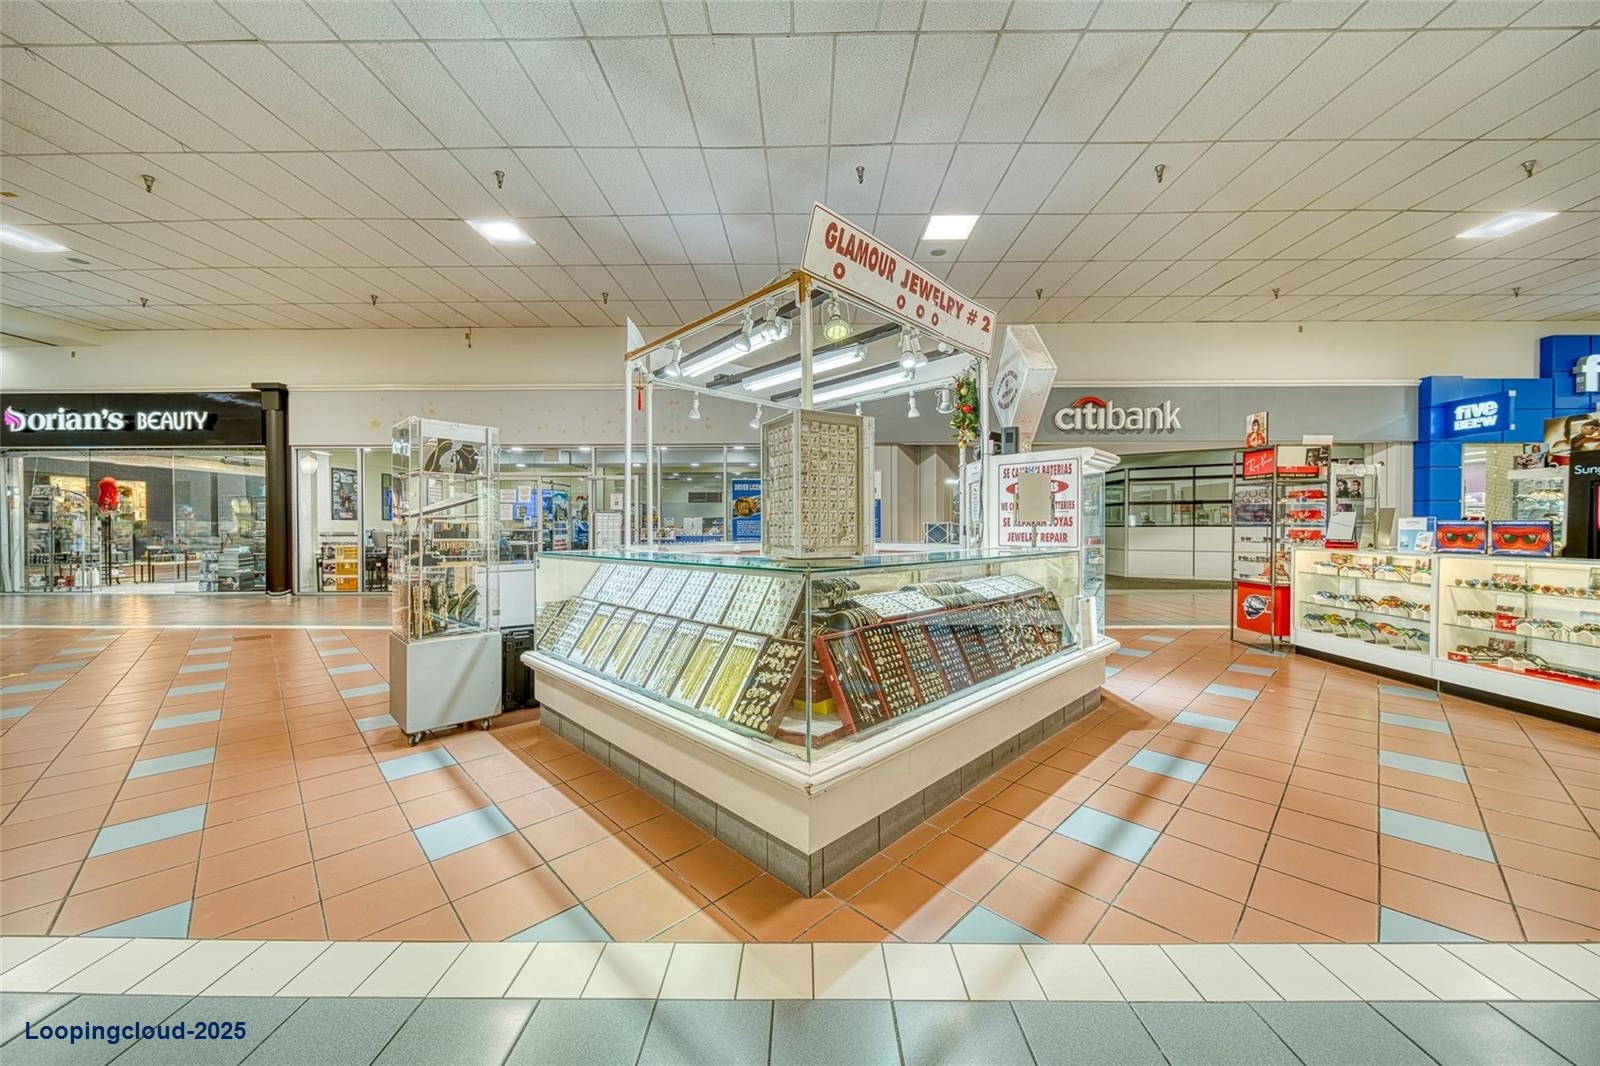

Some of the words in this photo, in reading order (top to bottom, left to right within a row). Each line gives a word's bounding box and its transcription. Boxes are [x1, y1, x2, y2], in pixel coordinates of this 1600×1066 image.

[824, 221, 897, 283] GLAMOUR
[900, 268, 965, 320] JEWELRY
[966, 308, 978, 326] #
[981, 315, 991, 334] 2
[4, 405, 125, 432] Dorian's
[137, 411, 208, 430] BEAUTY
[1054, 398, 1182, 431] citibank
[1454, 400, 1499, 421] five
[1003, 468, 1010, 479] SE
[1003, 517, 1011, 527] SE
[1040, 532, 1068, 543] REPAIR
